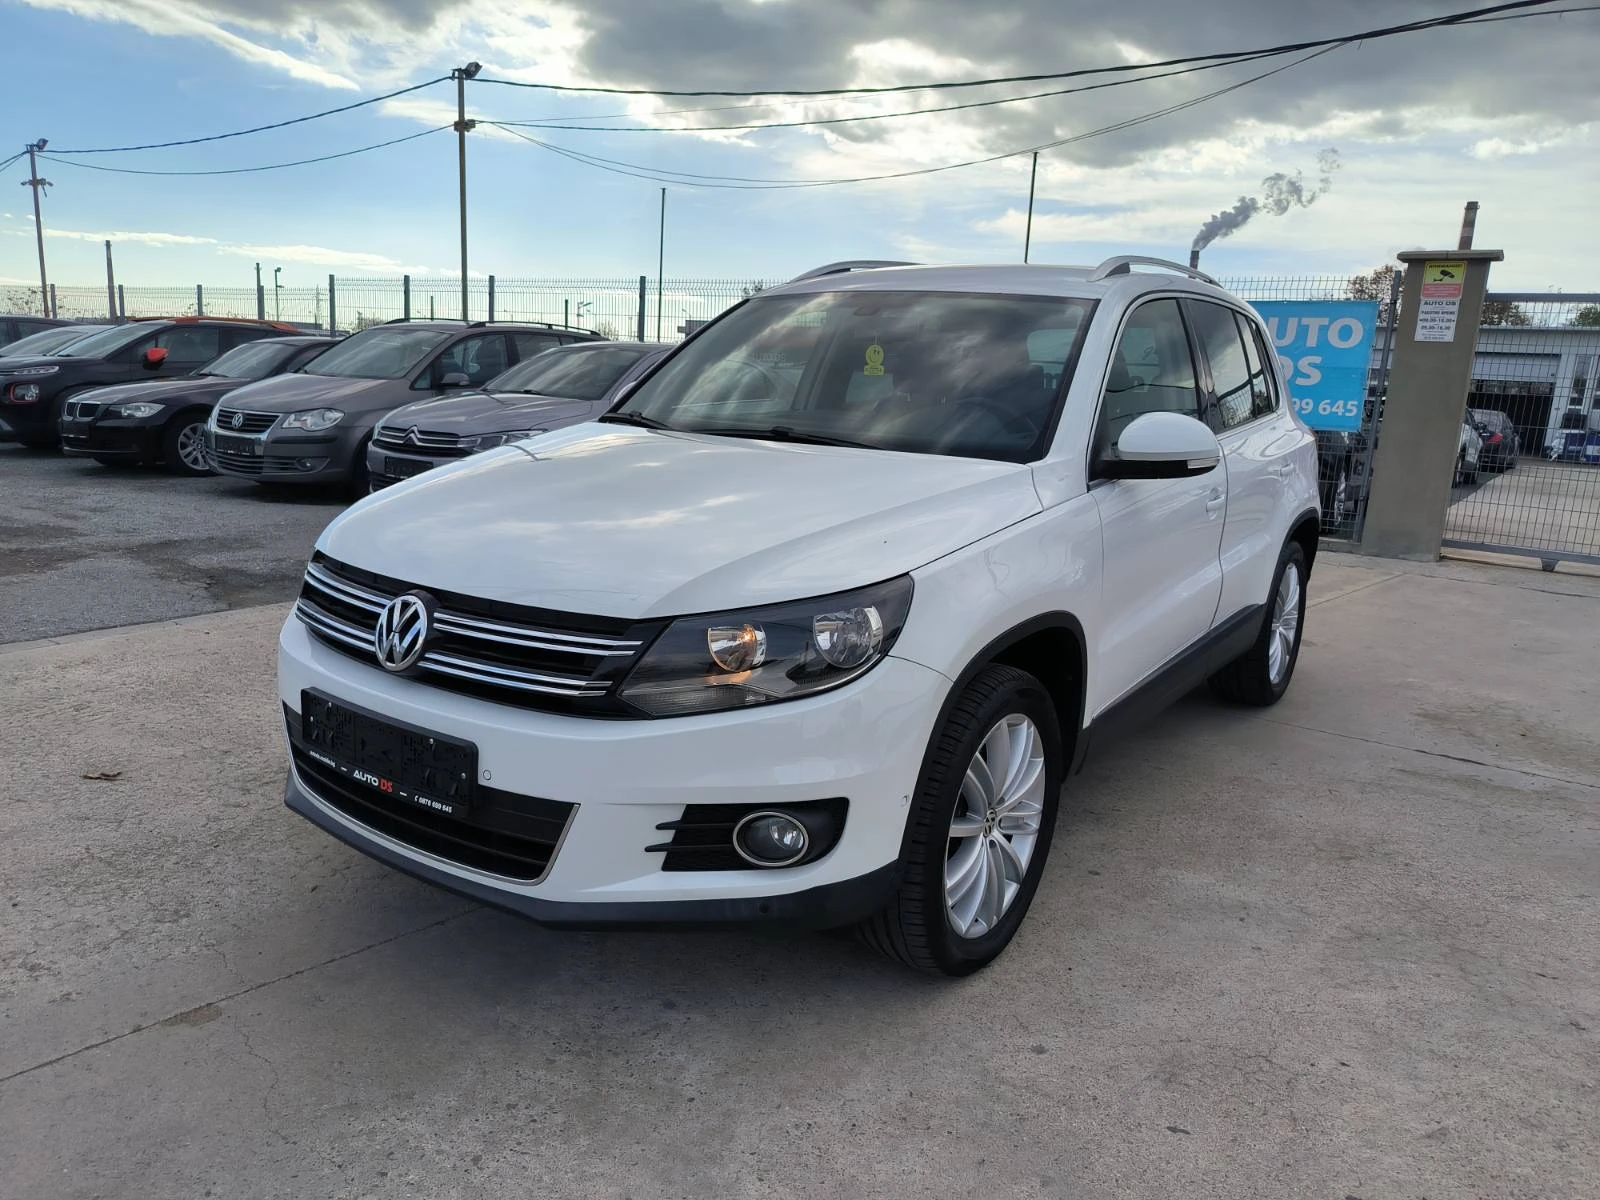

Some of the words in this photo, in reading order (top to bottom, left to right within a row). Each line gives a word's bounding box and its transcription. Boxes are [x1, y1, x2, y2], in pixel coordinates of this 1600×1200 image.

[1267, 317, 1364, 349] UTO
[1318, 399, 1358, 417] 645
[353, 769, 379, 786] AUTO
[380, 778, 393, 792] DS
